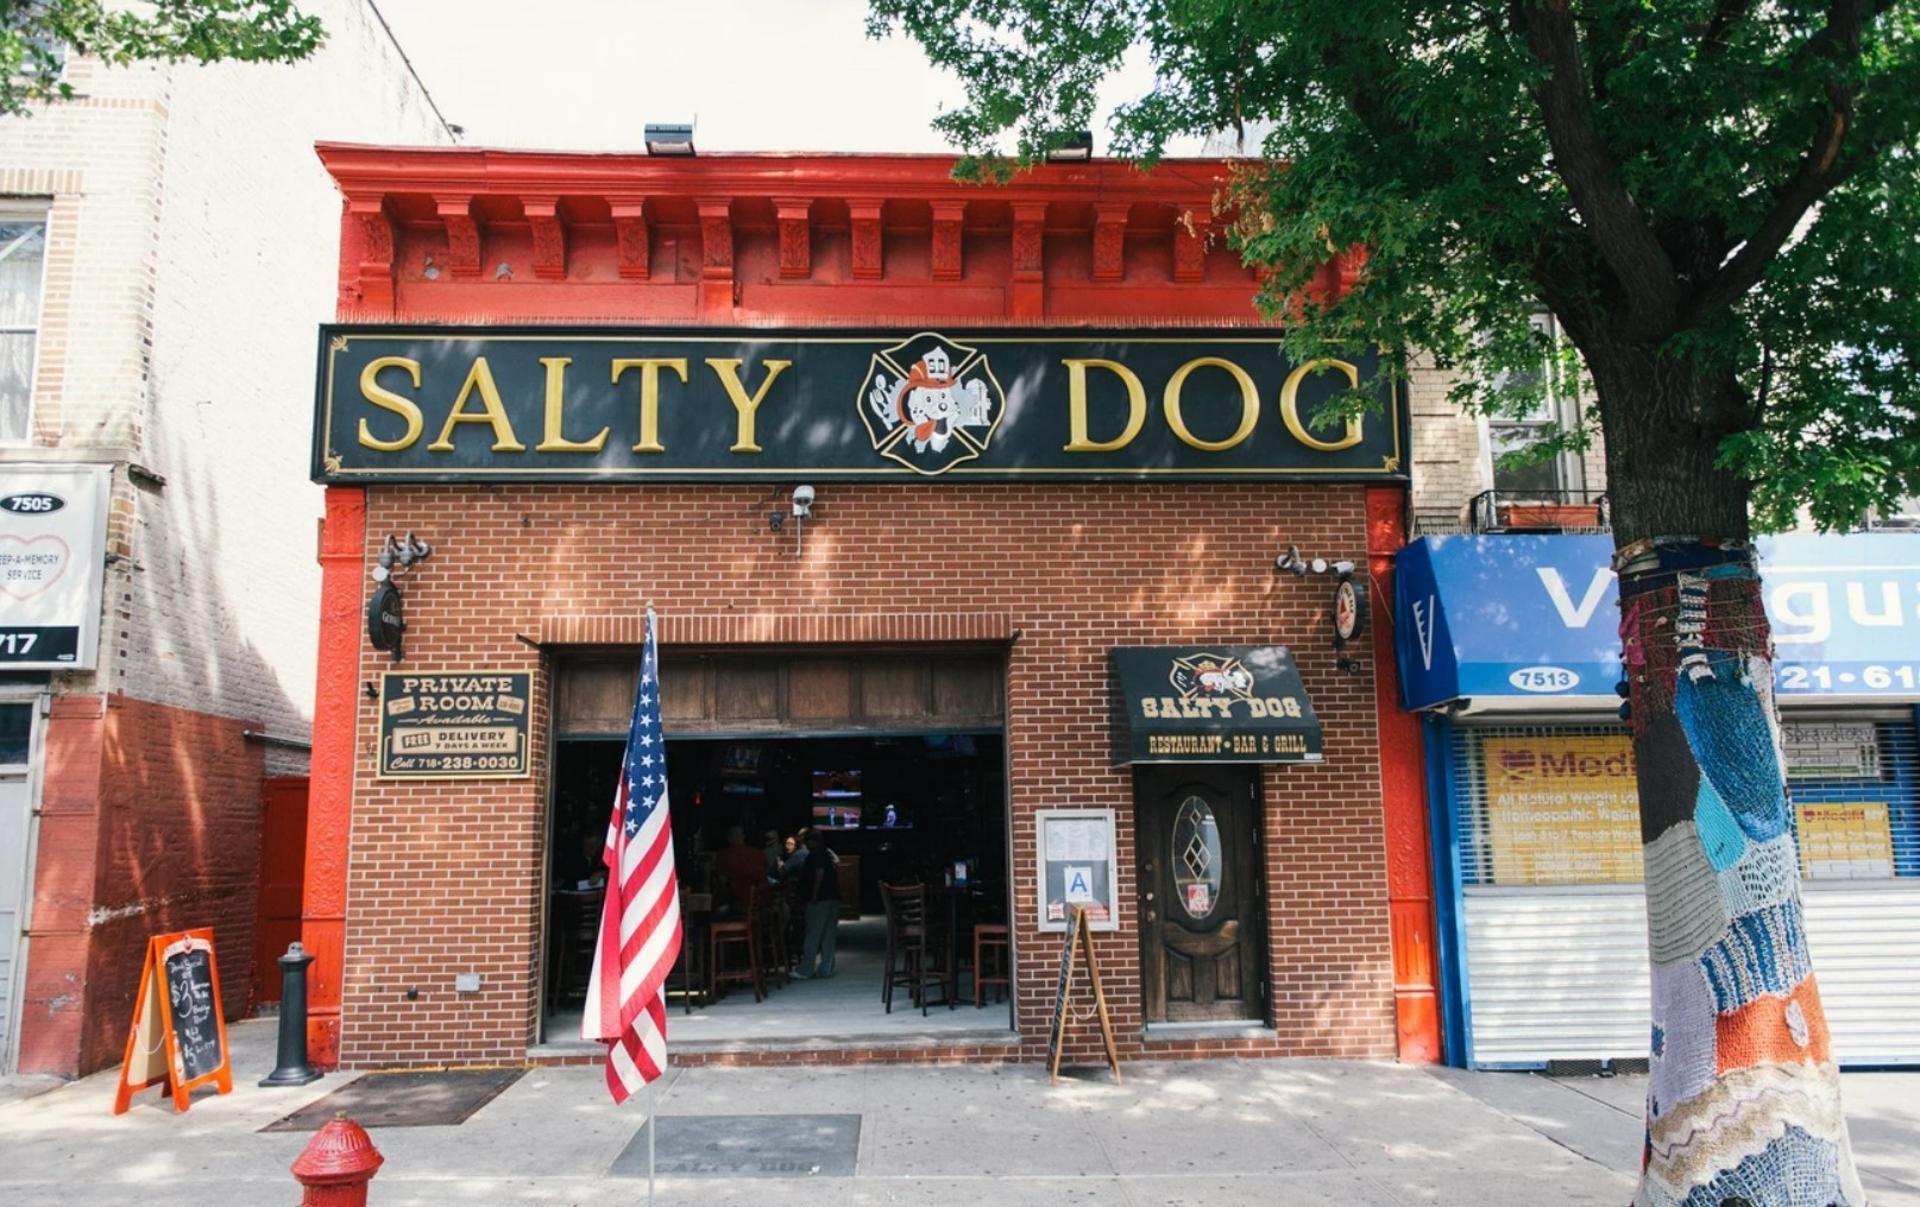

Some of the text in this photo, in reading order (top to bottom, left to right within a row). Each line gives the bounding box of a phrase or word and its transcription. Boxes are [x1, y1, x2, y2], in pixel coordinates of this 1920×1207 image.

[358, 355, 1366, 454] SALTY DOG
[12, 497, 52, 511] 7505
[0, 633, 38, 654] 17
[402, 677, 513, 693] PRIVATE
[1519, 672, 1571, 686] 7513
[419, 695, 495, 711] ROOM
[1141, 697, 1302, 719] SALTY DOG
[417, 713, 493, 725] Available
[404, 732, 506, 748] FREE DELIVERY
[1274, 735, 1308, 753] GRILL
[390, 757, 415, 769] Call
[1070, 871, 1088, 893] A
